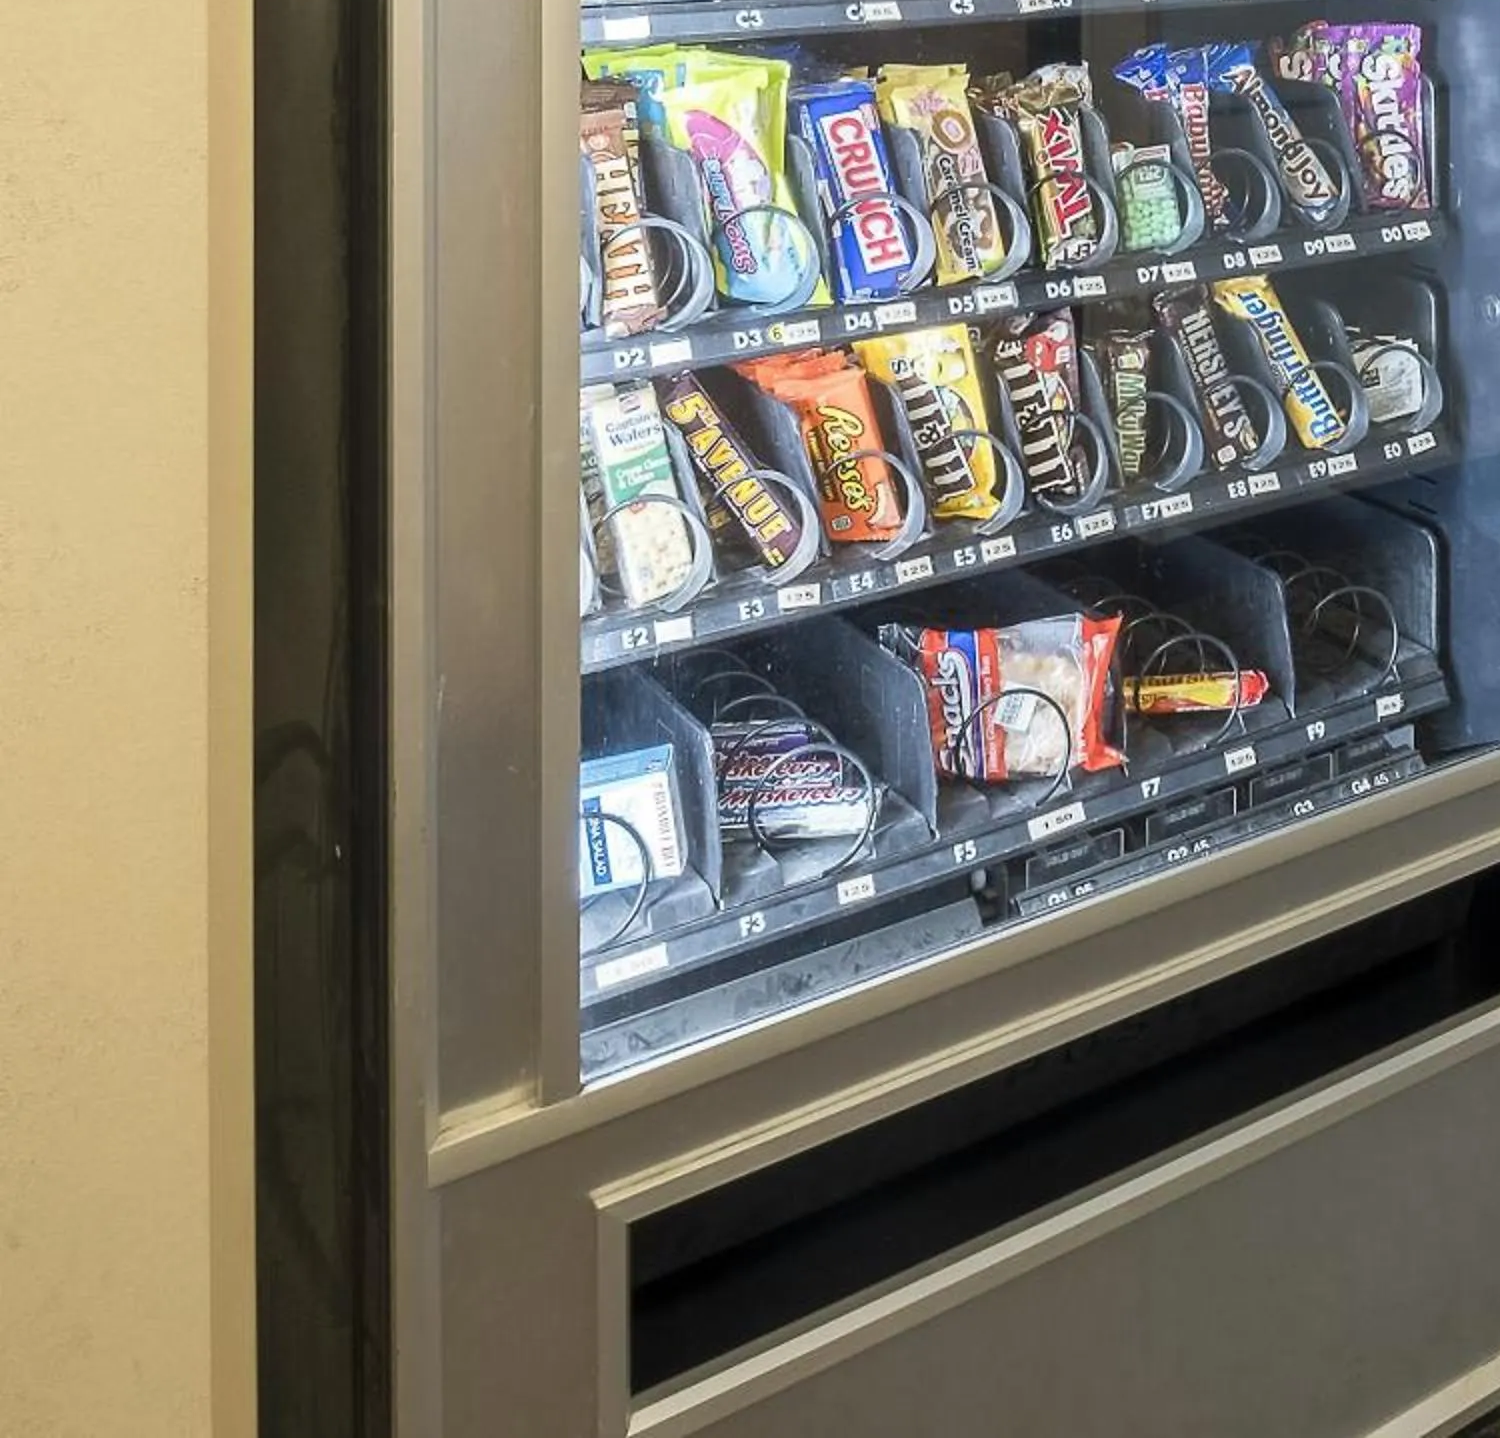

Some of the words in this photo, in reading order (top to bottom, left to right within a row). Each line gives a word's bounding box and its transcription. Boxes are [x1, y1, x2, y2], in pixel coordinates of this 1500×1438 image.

[735, 10, 764, 29] C3
[845, 4, 862, 21] C
[1219, 64, 1306, 160] Almond
[1285, 150, 1330, 200] Joy
[1361, 50, 1413, 202] Skittles
[1037, 107, 1091, 239] TWIX
[829, 117, 904, 264] CRUNCH
[1304, 239, 1325, 256] D9
[1223, 252, 1247, 269] D8
[1137, 266, 1158, 283] D7
[1045, 281, 1072, 298] D6
[949, 297, 974, 314] D5
[844, 313, 872, 331] D4
[733, 330, 763, 350] D3
[613, 346, 645, 367] D2
[1238, 291, 1341, 439] Butterfinger
[609, 424, 662, 447] Wafers
[816, 404, 875, 513] Reese's
[1309, 461, 1328, 478] E9
[685, 424, 794, 543] AVENUE
[1228, 481, 1248, 498] E8
[1142, 503, 1161, 520] E7
[1051, 524, 1073, 543] E6
[953, 549, 976, 567] E5
[848, 575, 875, 595] E4
[738, 600, 766, 621] E3
[621, 627, 649, 649] E2
[1306, 721, 1326, 742] F9
[1140, 776, 1162, 799] F7
[1351, 778, 1371, 795] G4
[953, 840, 977, 863] F5
[739, 911, 767, 937] F3
